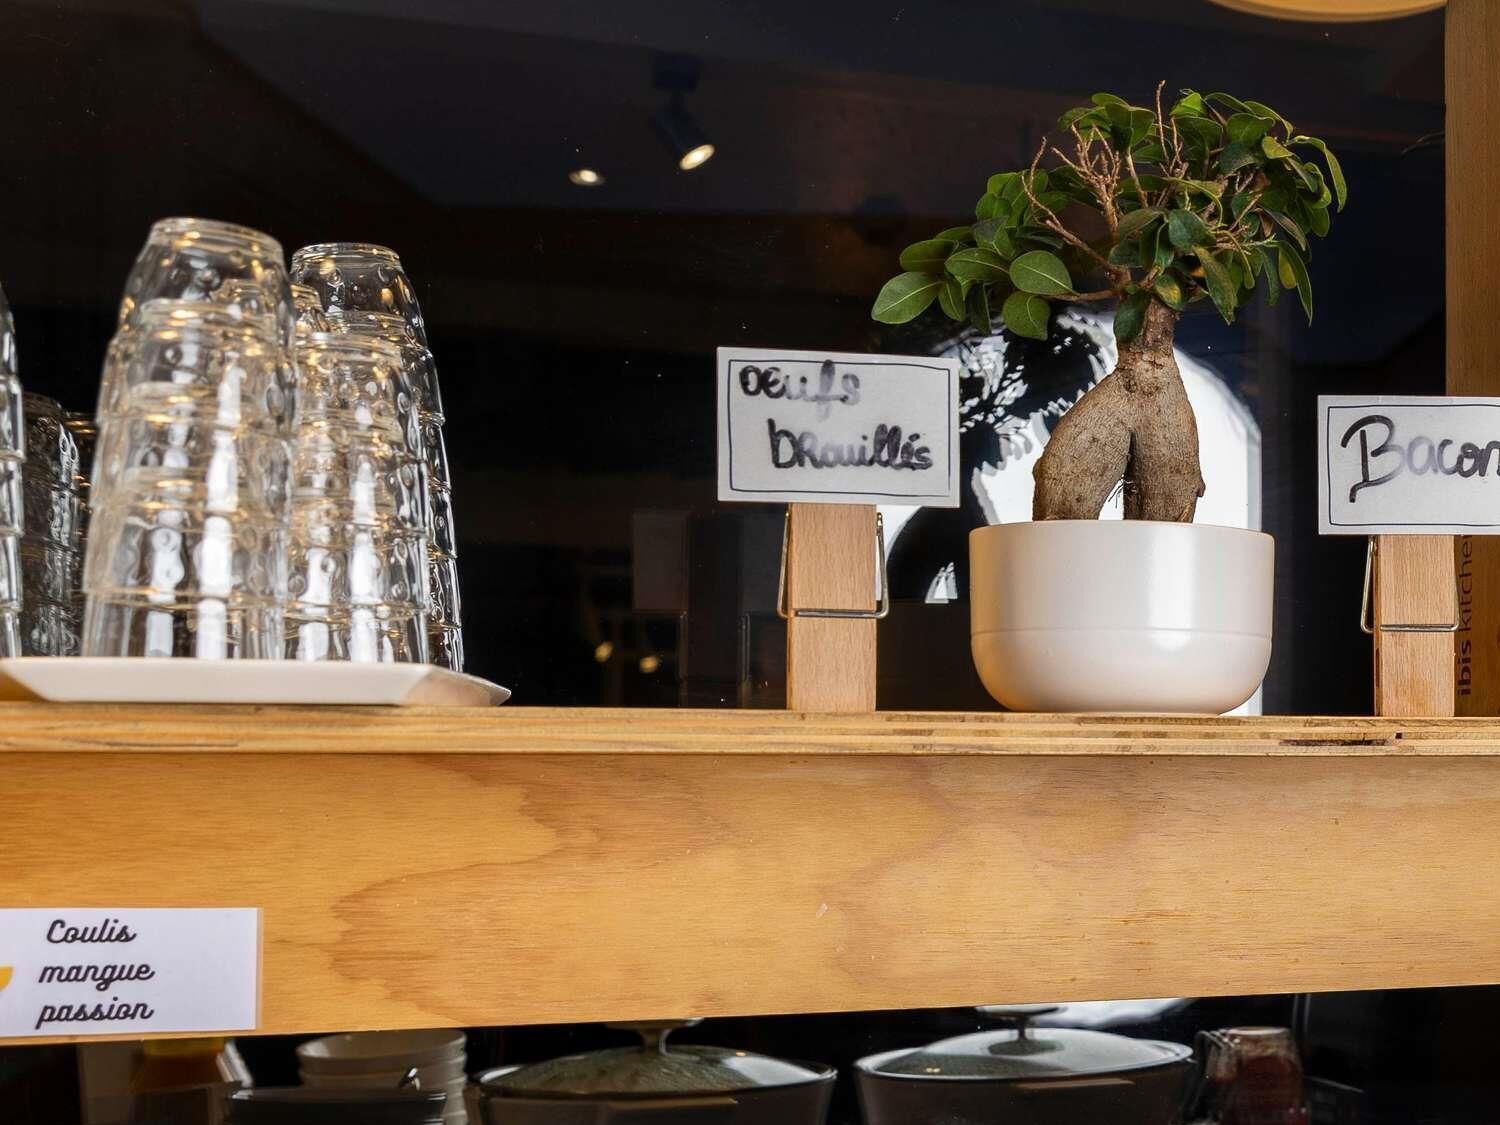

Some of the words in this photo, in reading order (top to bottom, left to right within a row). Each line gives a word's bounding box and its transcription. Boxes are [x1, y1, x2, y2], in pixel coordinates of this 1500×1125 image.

[1457, 638, 1473, 696] ibis
[46, 918, 137, 944] Coulis
[37, 962, 156, 992] mangue
[34, 996, 155, 1030] passion
